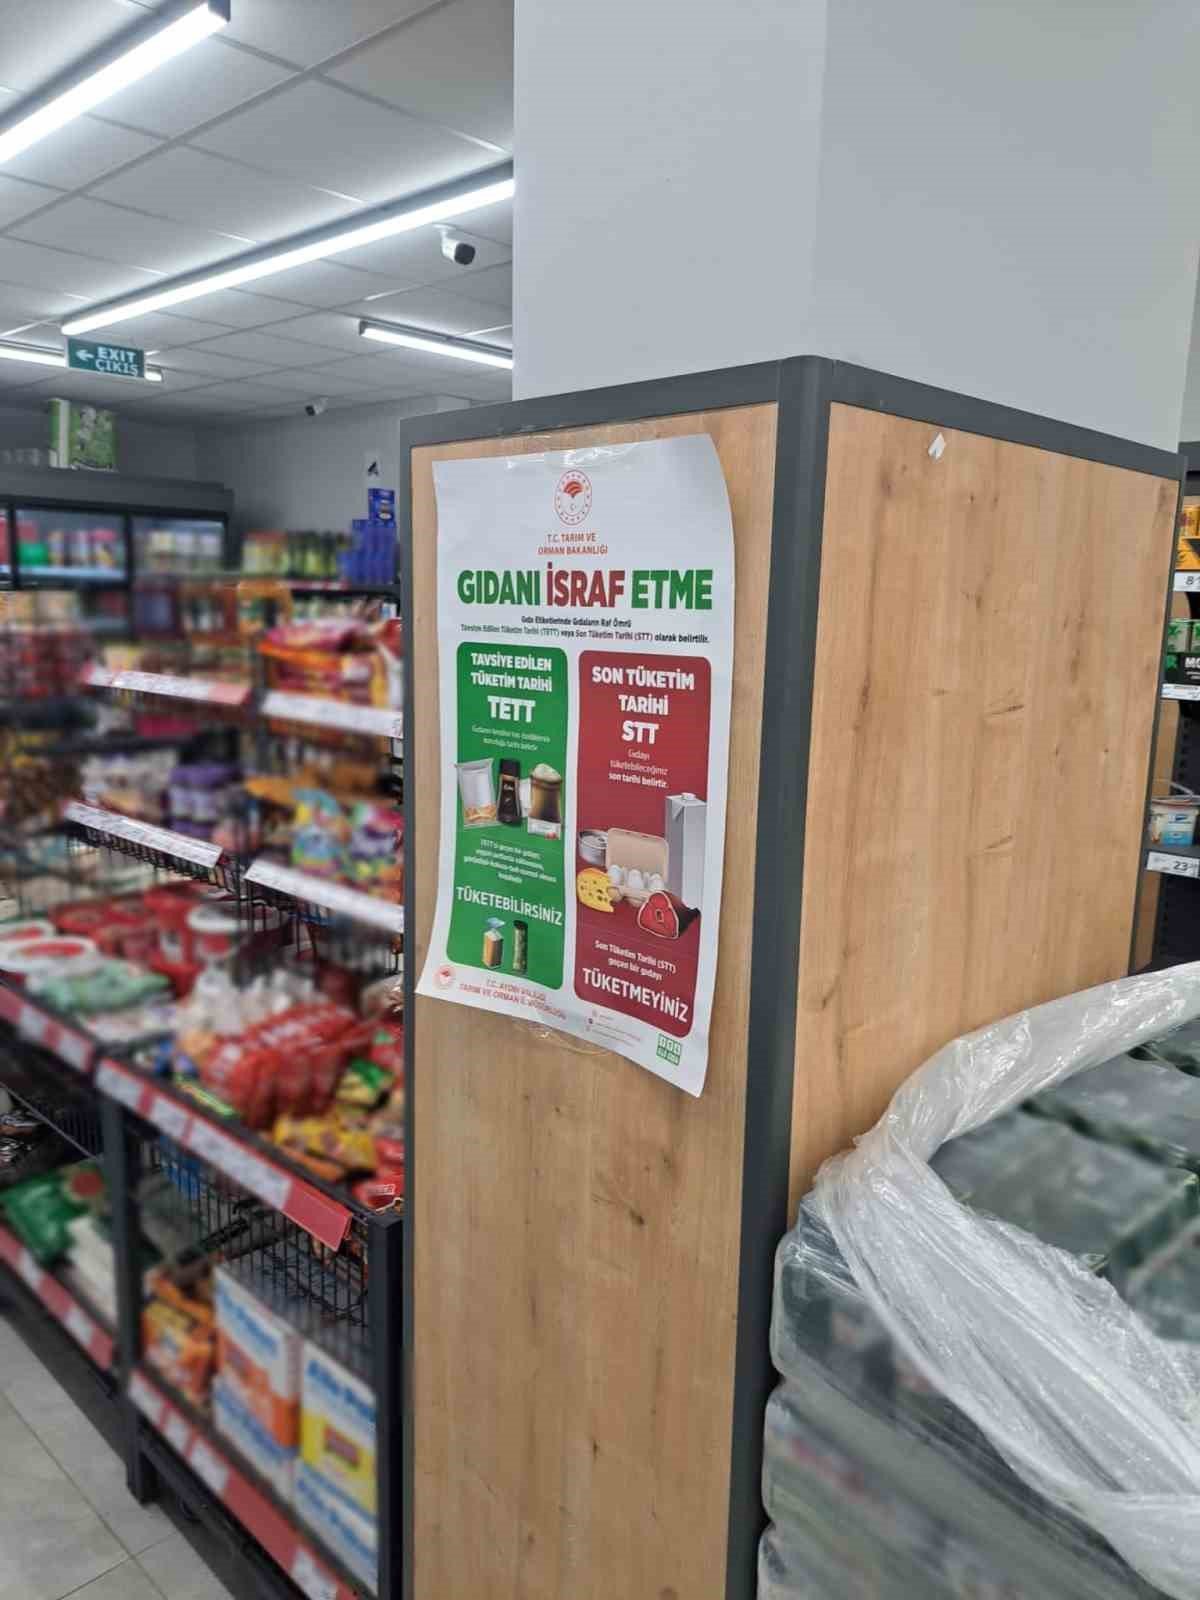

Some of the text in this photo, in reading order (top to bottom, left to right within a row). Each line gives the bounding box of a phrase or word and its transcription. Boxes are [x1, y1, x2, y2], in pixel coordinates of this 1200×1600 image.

[97, 347, 136, 363] EXIT
[561, 533, 584, 542] TARIM
[585, 533, 597, 542] VE
[538, 546, 564, 554] ORMAN
[457, 561, 713, 610] GIDANI İSRAF ETME
[575, 630, 587, 638] Son
[634, 632, 653, 641] (STT)
[654, 633, 677, 642] olarak
[470, 651, 552, 672] TAVSİYE EDİLEN
[470, 670, 552, 692] TÜKETİM TARİHİ
[592, 665, 695, 690] SON TÜKETİM
[487, 695, 536, 723] TETT
[618, 693, 669, 715] TARİHİ
[622, 720, 659, 744] STT
[456, 886, 562, 926] TÜKETEBİLİRSİNİZ
[594, 940, 608, 951] Son
[609, 944, 636, 959] Tüketim
[657, 960, 677, 974] (STT)
[582, 967, 688, 1023] TÜKETMEYİNİZ
